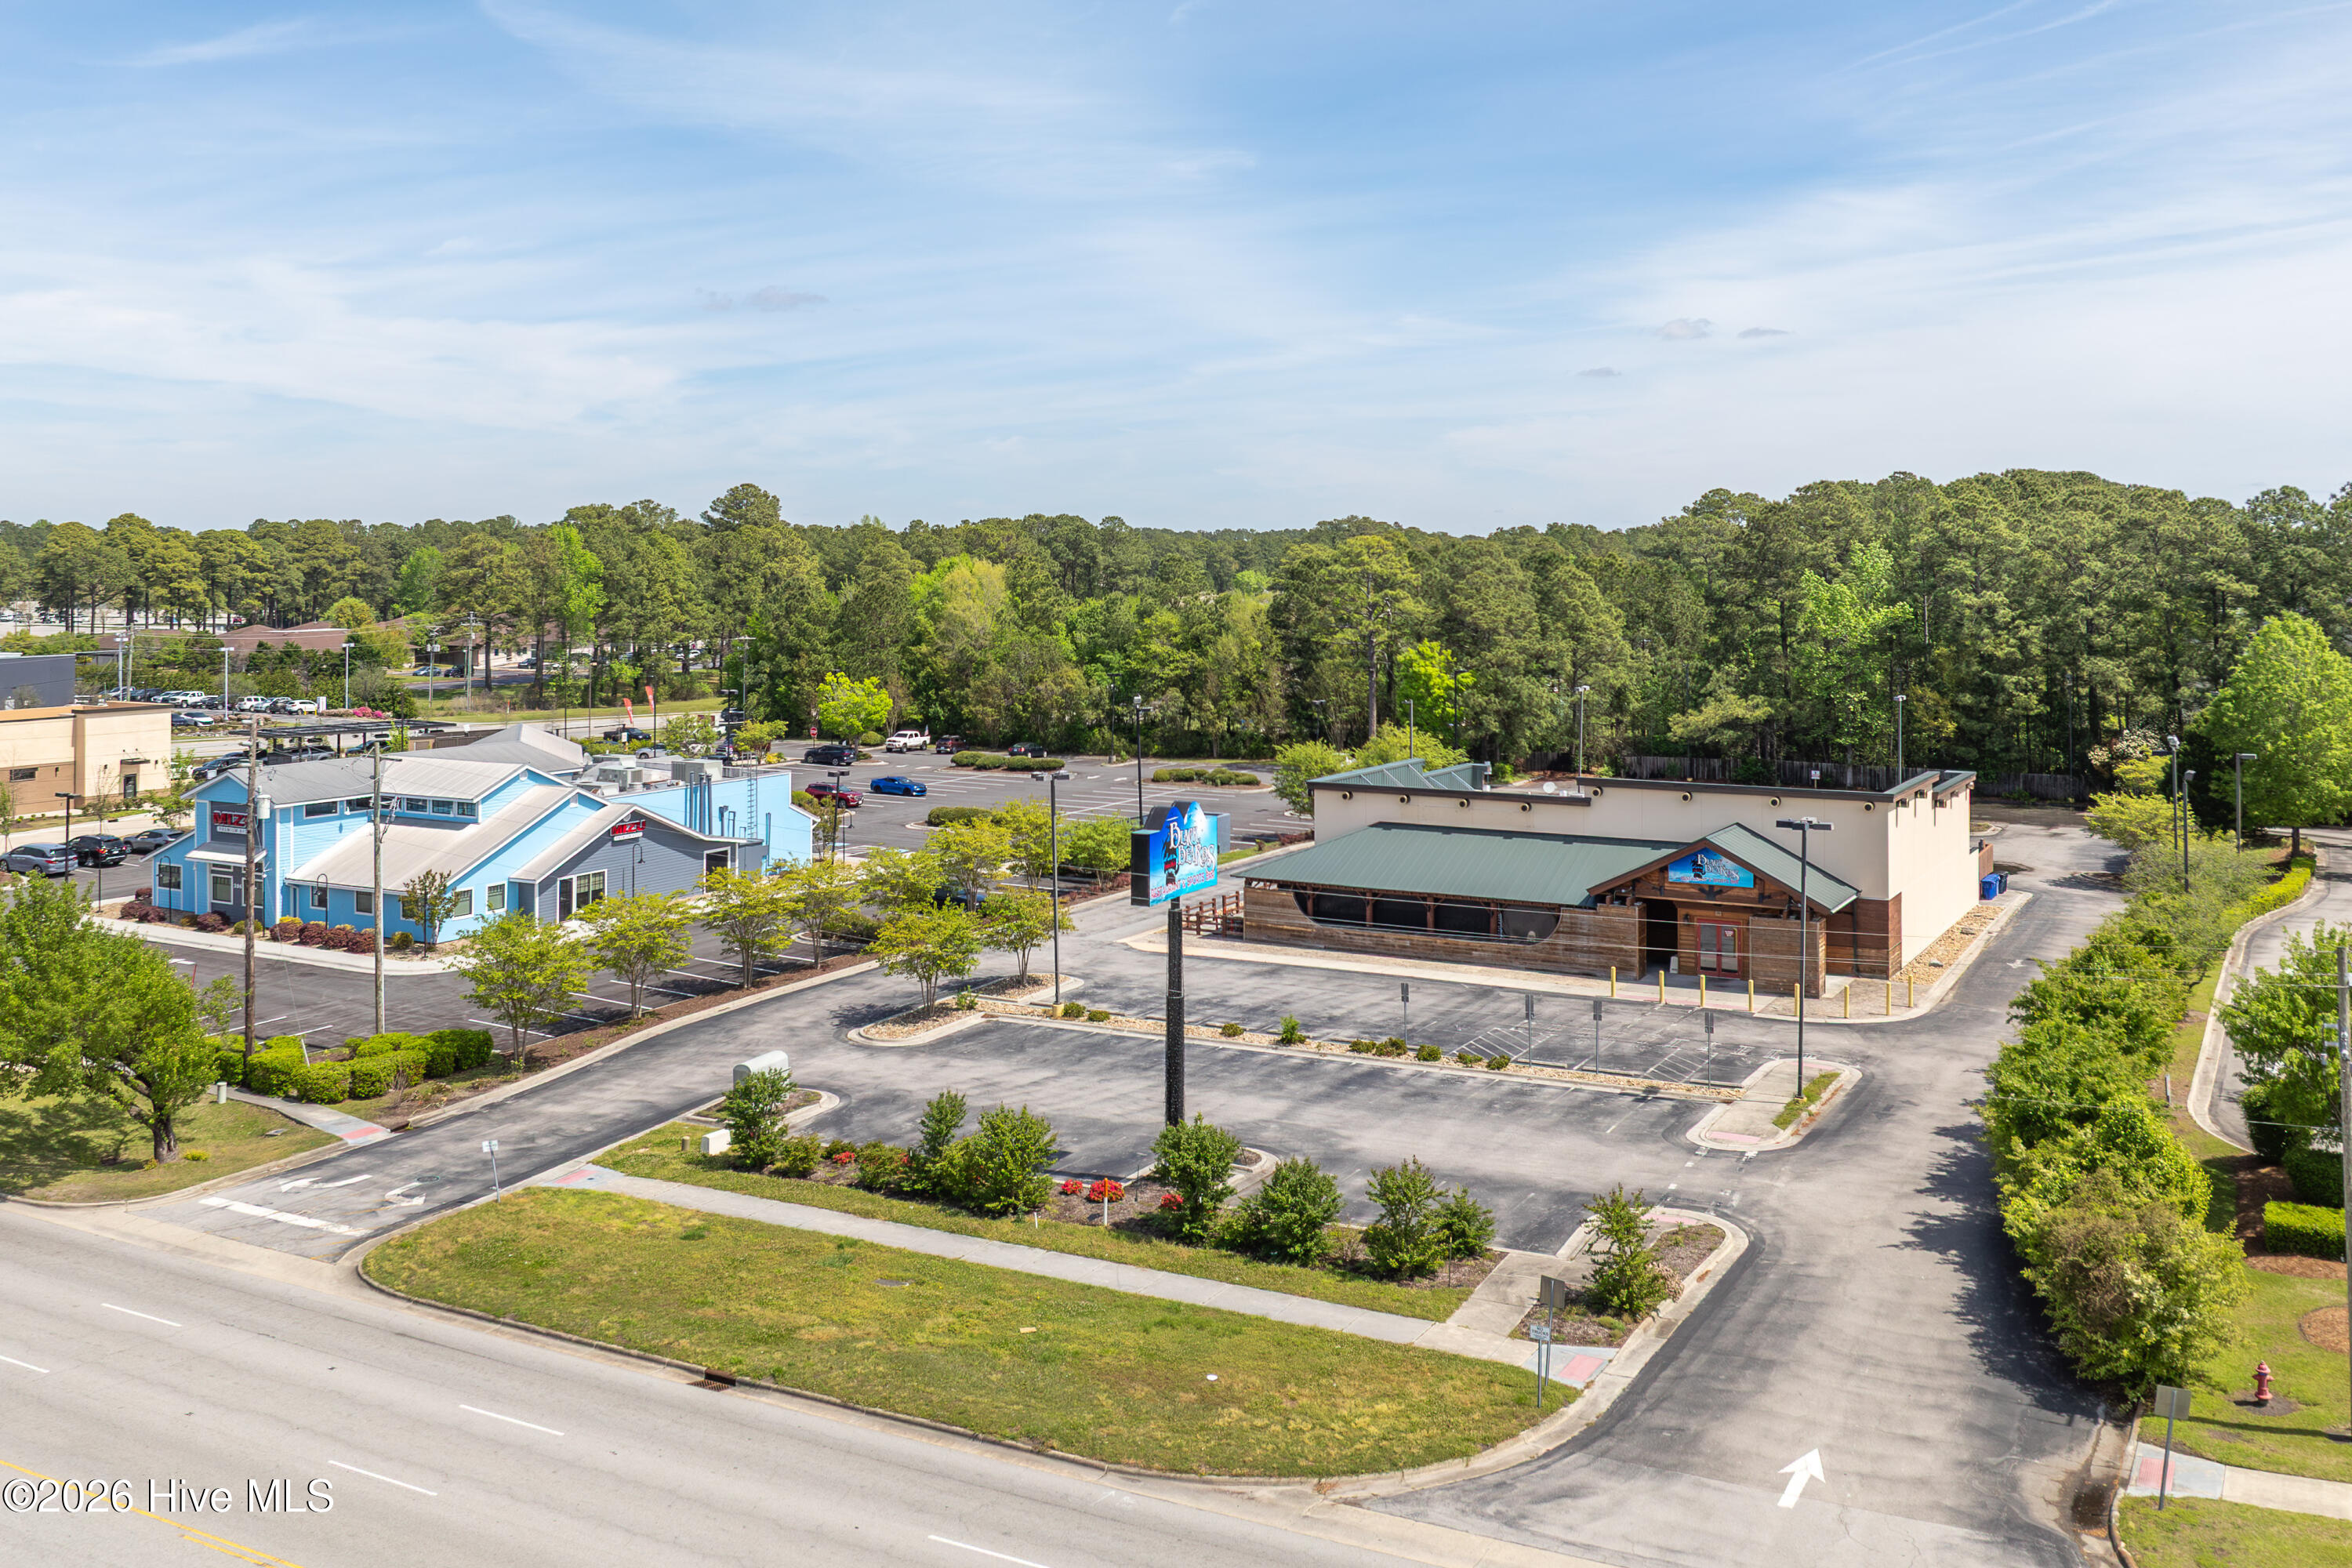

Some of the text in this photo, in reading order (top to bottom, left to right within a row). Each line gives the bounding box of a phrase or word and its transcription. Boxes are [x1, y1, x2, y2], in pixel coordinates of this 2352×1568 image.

[212, 811, 256, 828] MIZ
[1151, 879, 1181, 898] RESTAURANT
[1187, 873, 1204, 887] SPORTS
[1206, 870, 1214, 880] BAR
